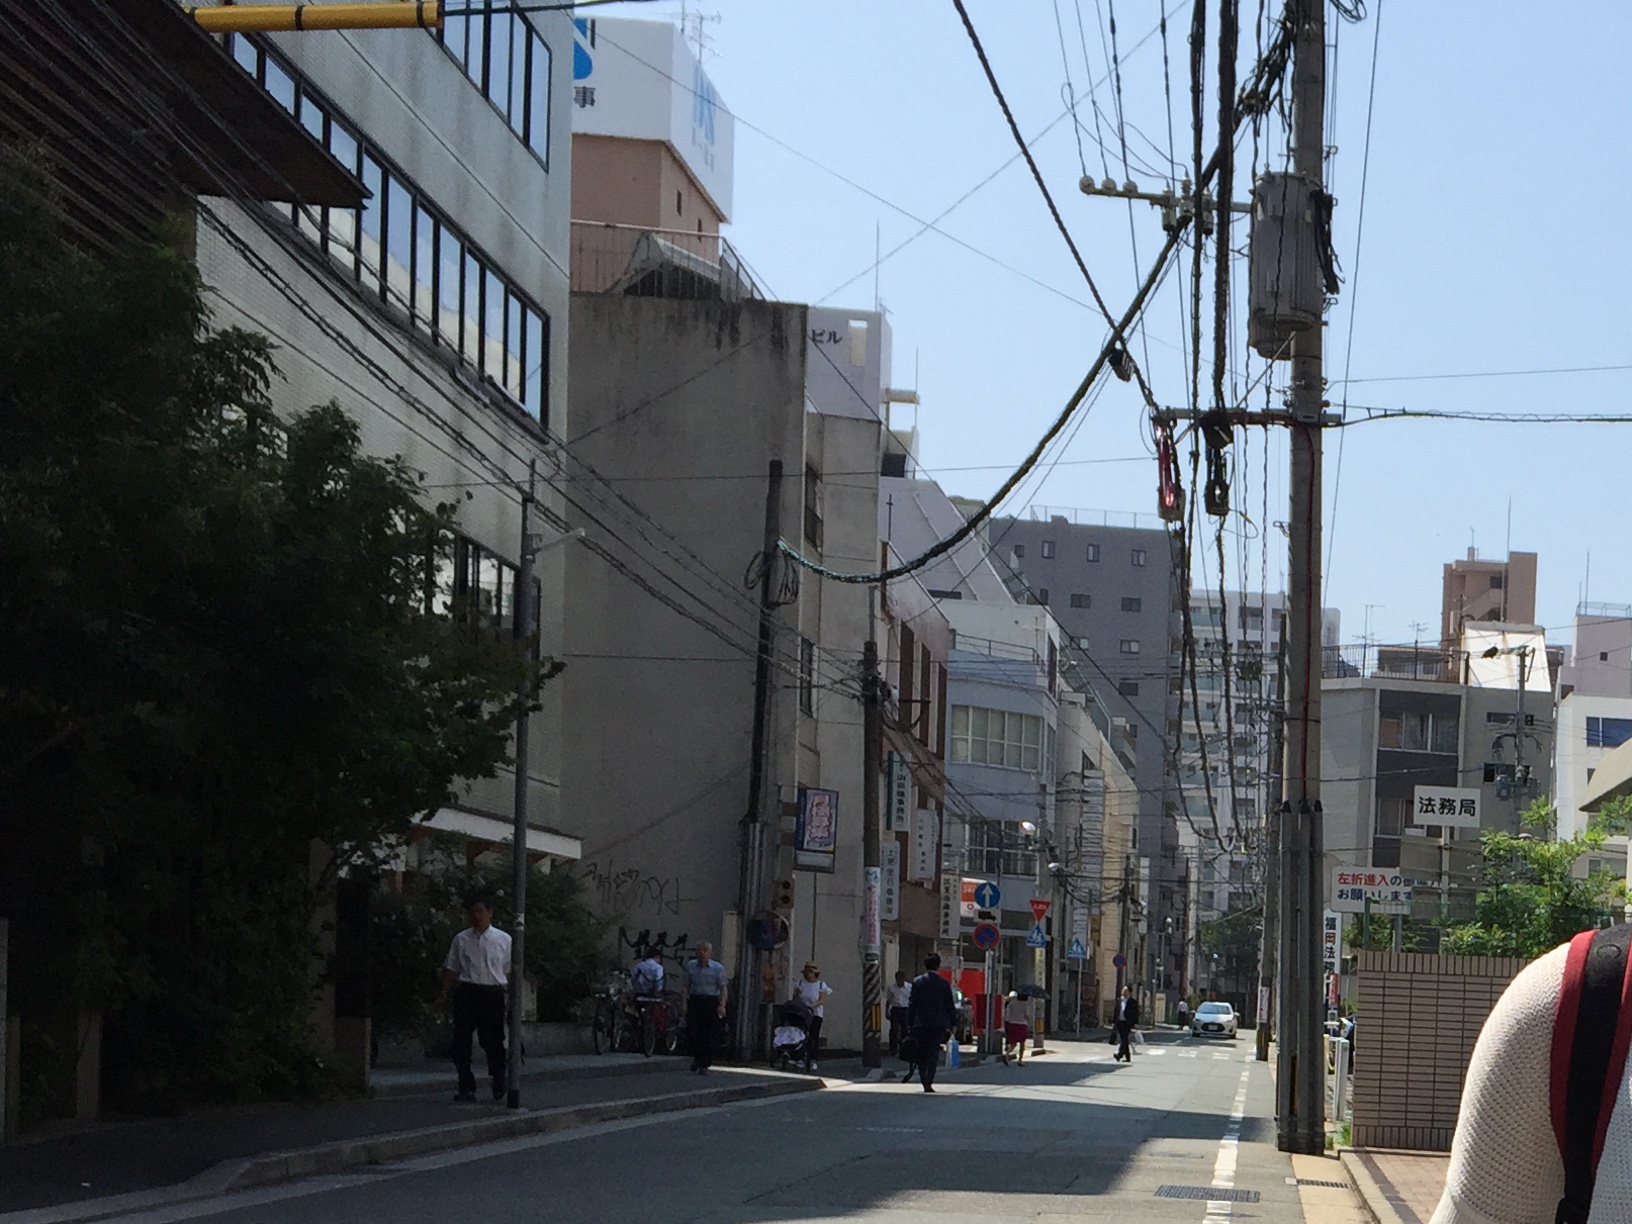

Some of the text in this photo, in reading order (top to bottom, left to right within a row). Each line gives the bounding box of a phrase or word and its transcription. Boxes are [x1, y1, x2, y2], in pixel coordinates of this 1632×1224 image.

[811, 329, 844, 345] ビル
[1418, 796, 1477, 817] 法務局
